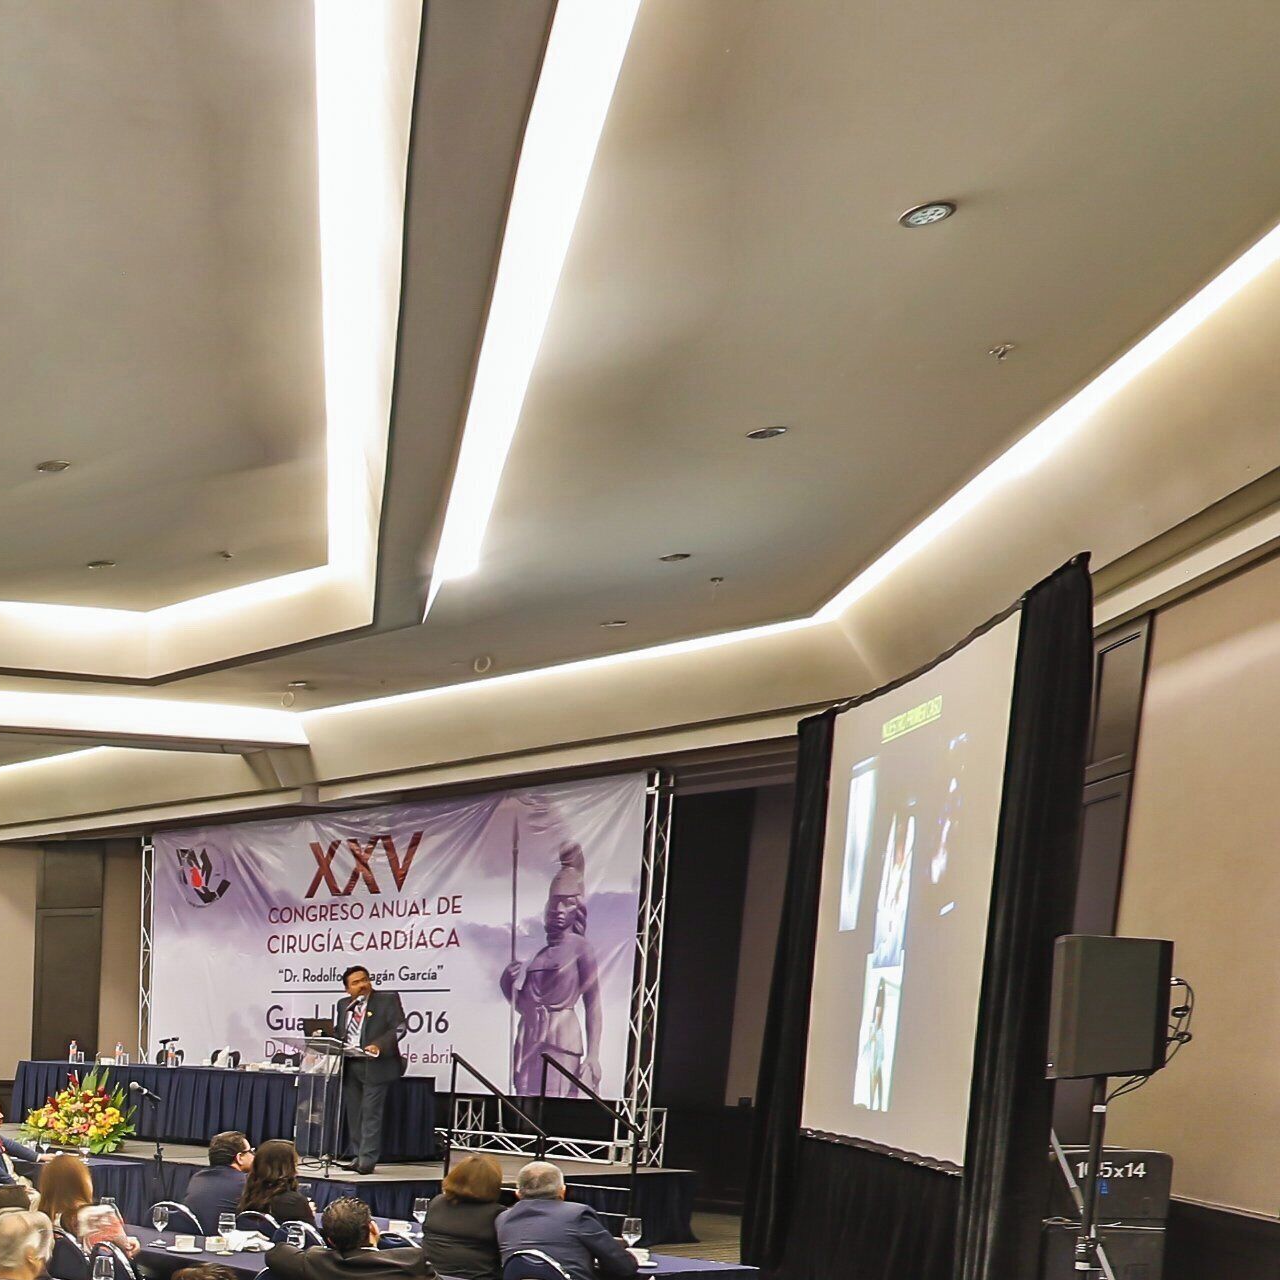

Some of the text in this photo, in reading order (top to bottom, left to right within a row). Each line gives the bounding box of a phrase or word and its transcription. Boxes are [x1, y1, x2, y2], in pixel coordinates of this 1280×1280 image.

[304, 831, 424, 898] XXV
[268, 895, 463, 924] CONGRESO ANUAL DE
[267, 923, 461, 954] CIRUGÍA CARDÍACA
[302, 967, 344, 982] Rodolfo
[397, 1011, 449, 1034] 016
